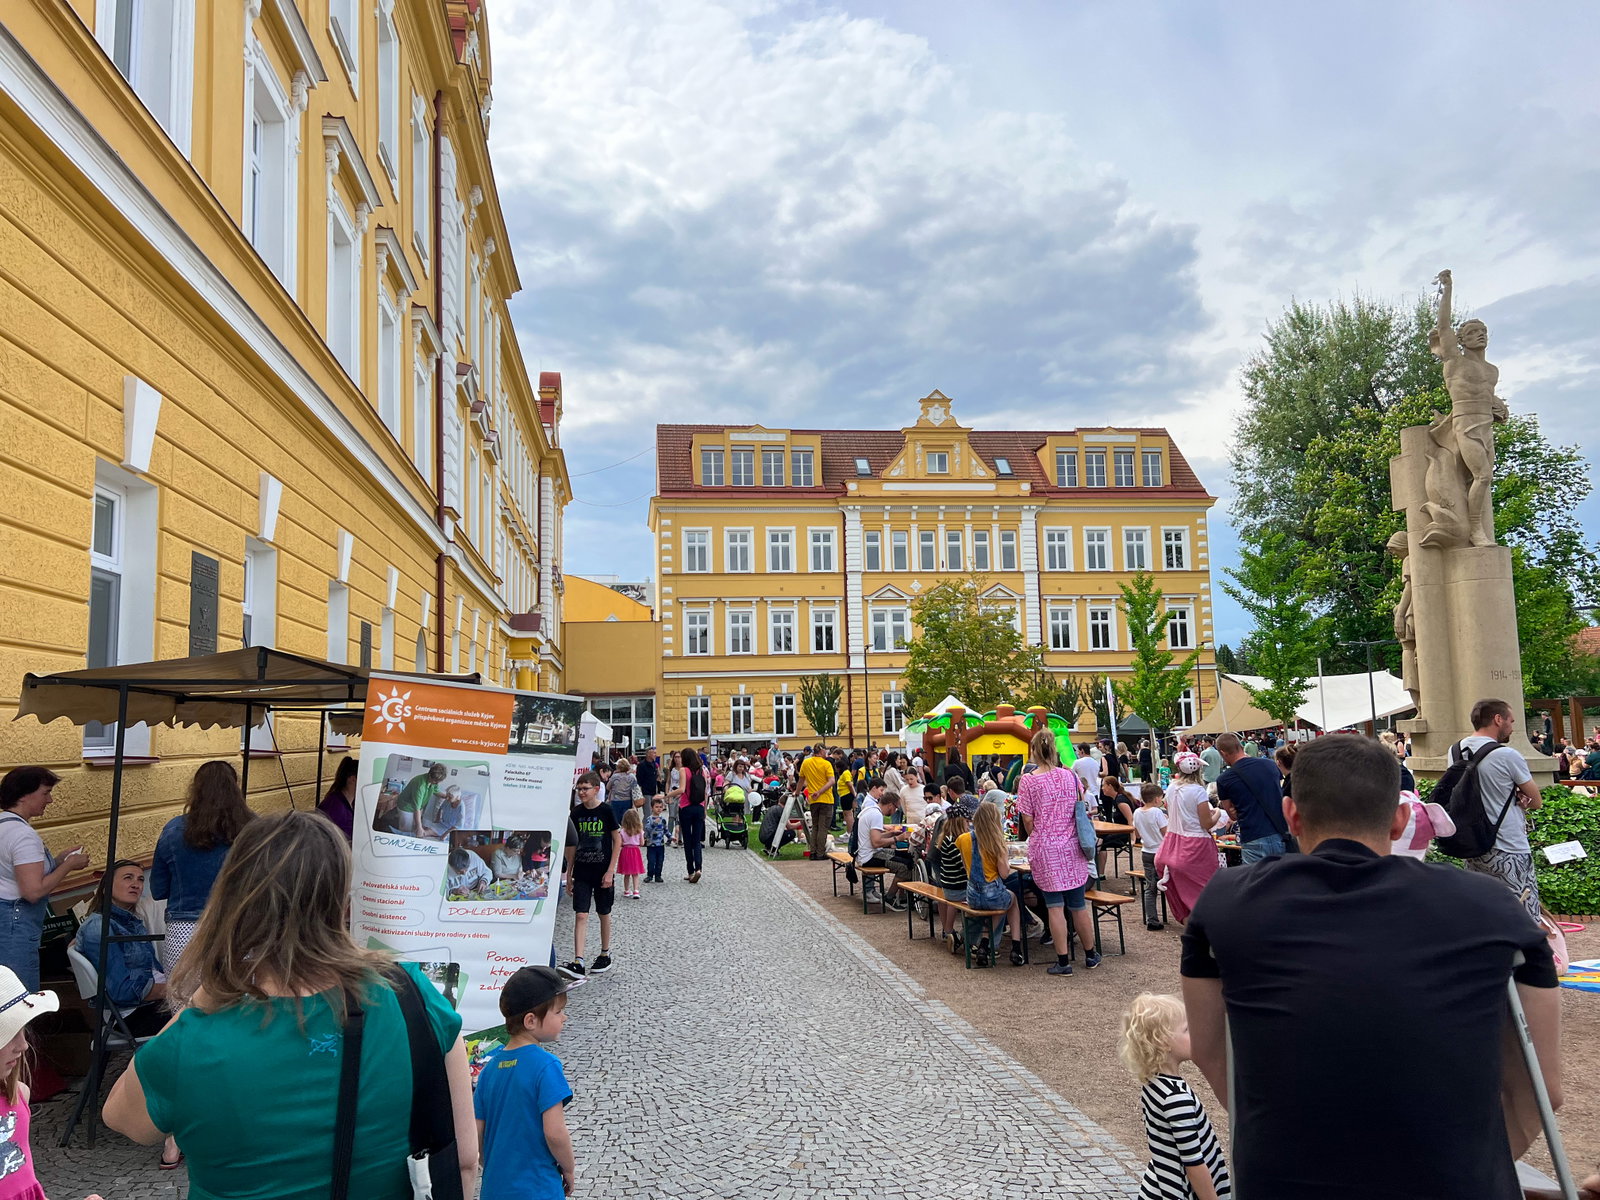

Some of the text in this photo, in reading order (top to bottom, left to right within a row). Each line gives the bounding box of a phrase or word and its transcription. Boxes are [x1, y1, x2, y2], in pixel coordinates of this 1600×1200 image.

[415, 705, 437, 713] Centrum
[438, 708, 464, 716] sociálních
[414, 714, 445, 722] příspěvková
[446, 718, 472, 726] organizace
[452, 738, 505, 748] www.css-kyjov.cz
[374, 835, 438, 854] POMŮŽEME
[362, 881, 398, 890] Pečovatelská
[362, 910, 378, 918] Osobní
[381, 928, 414, 936] aktivizační
[414, 930, 434, 939] služby
[486, 950, 528, 964] Pomoc,
[490, 966, 516, 976] kter
